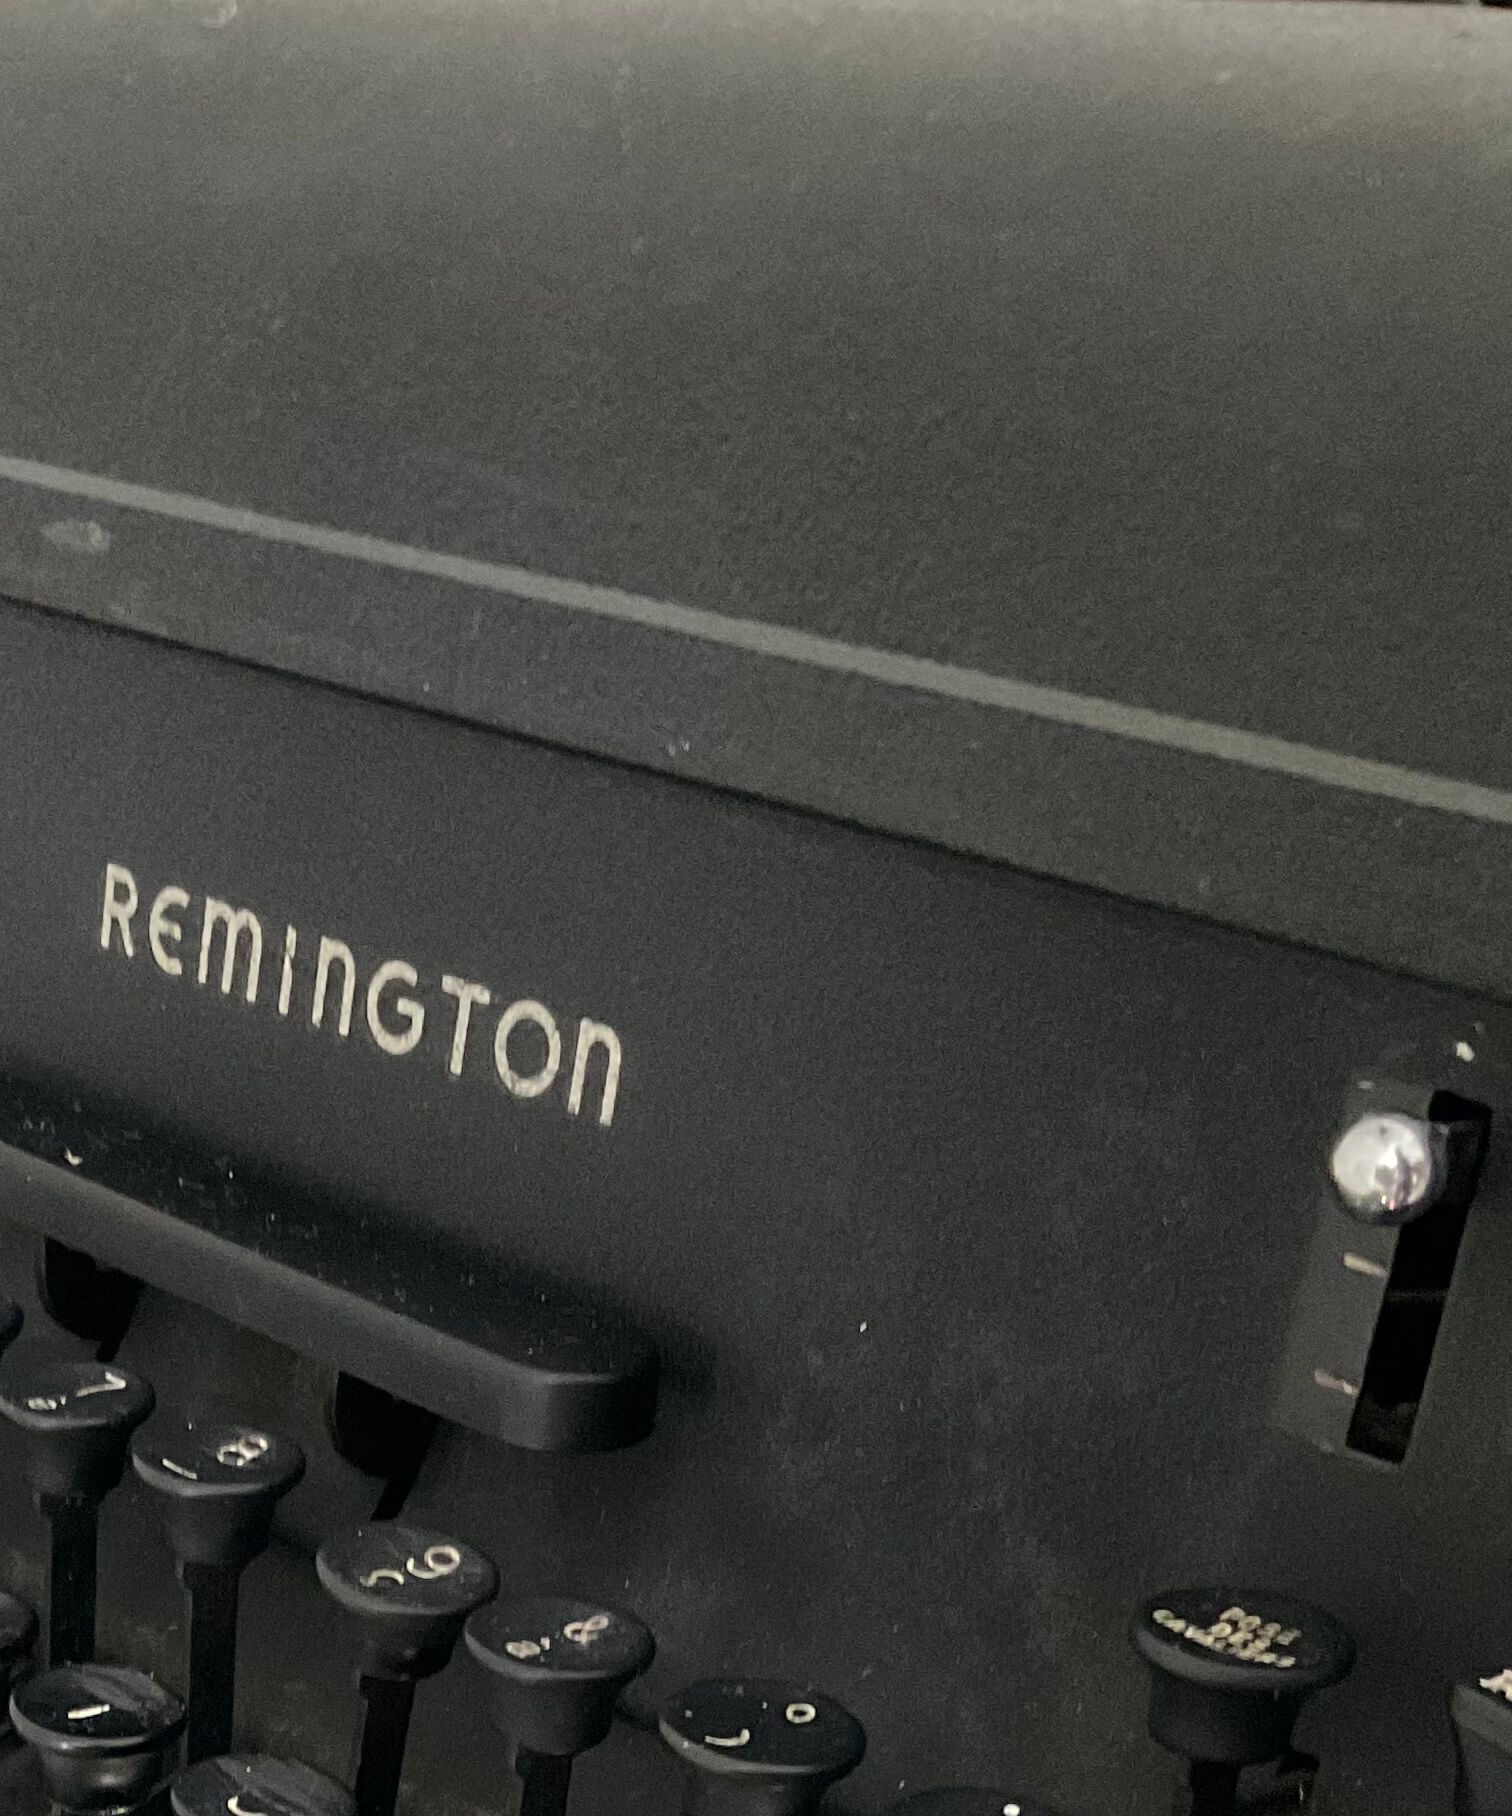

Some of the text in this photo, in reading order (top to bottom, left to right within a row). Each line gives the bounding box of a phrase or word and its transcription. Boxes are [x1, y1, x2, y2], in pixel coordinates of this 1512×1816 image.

[100, 862, 622, 1127] REMINGTON
[216, 1435, 269, 1467] 8
[406, 1545, 461, 1580] 9
